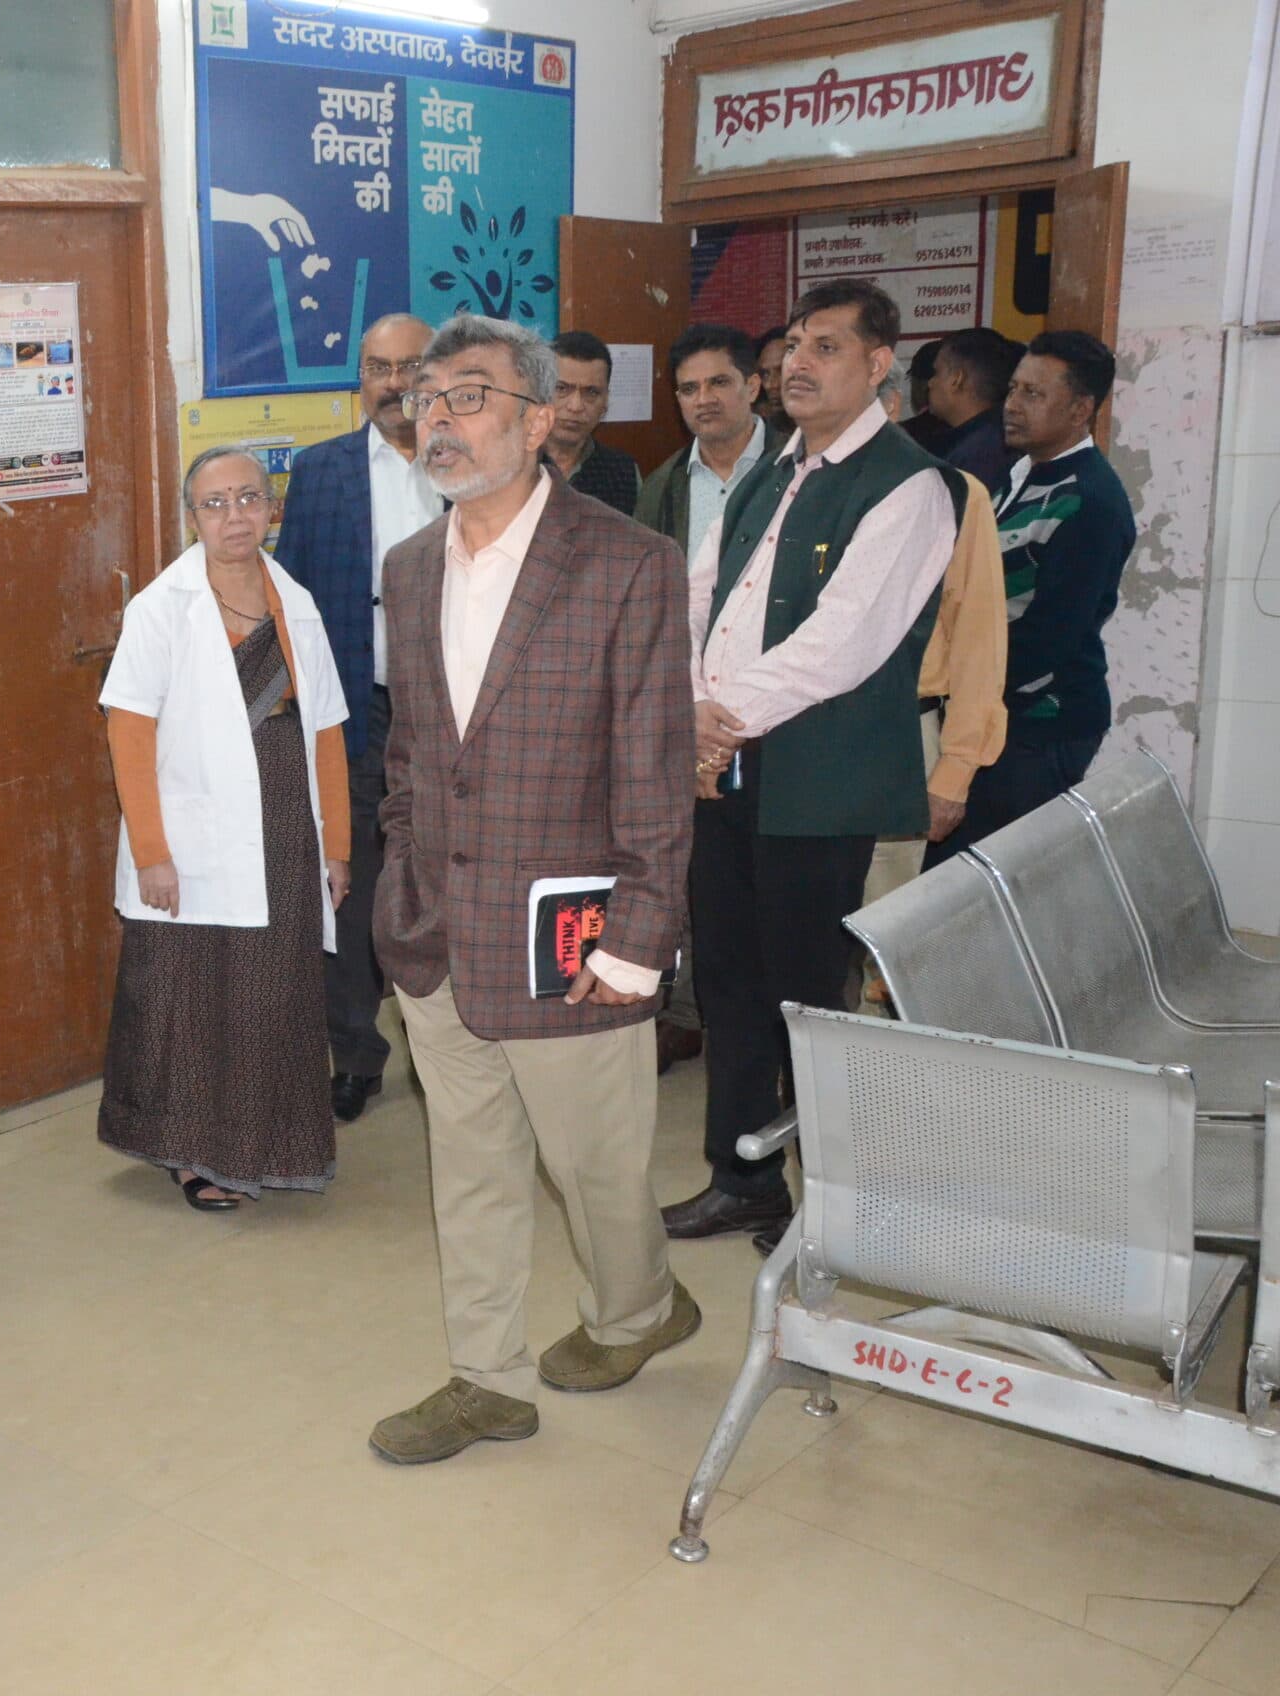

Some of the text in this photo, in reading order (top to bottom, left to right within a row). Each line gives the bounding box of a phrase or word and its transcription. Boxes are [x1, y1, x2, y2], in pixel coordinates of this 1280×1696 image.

[273, 16, 524, 75] सदर अस्पताल, देवघर
[318, 82, 396, 124] सफाई
[419, 88, 474, 133] सेहत
[311, 124, 392, 168] मिनटों
[420, 134, 481, 175] सालों
[354, 171, 390, 212] की
[421, 176, 454, 216] की
[562, 919, 576, 963] THINK
